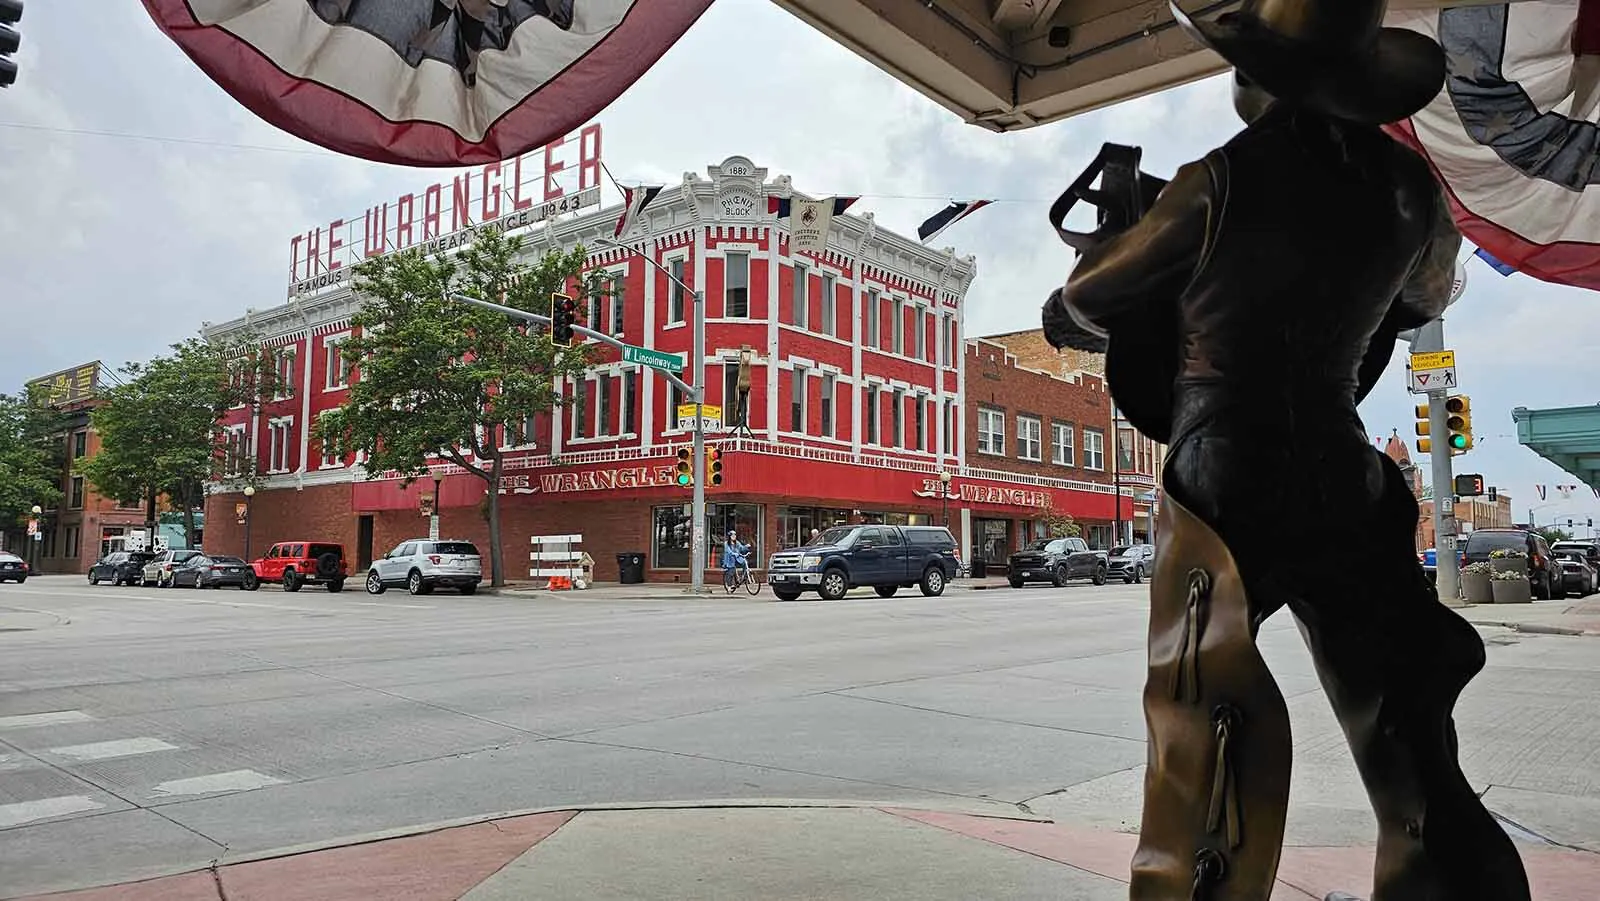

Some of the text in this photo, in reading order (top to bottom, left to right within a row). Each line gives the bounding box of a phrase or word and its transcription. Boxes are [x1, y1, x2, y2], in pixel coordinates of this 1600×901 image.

[730, 167, 747, 175] 1882
[291, 123, 601, 283] THE WRANGLER
[726, 208, 750, 216] BLOCK
[297, 271, 342, 294] FAMOUS
[427, 231, 468, 253] WEAR
[541, 196, 580, 220] 1943
[624, 346, 632, 360] W
[634, 349, 671, 369] Lincolnway
[540, 465, 694, 493] WRANGLE
[1474, 478, 1481, 493] 3
[960, 483, 1052, 508] WRANGLER
